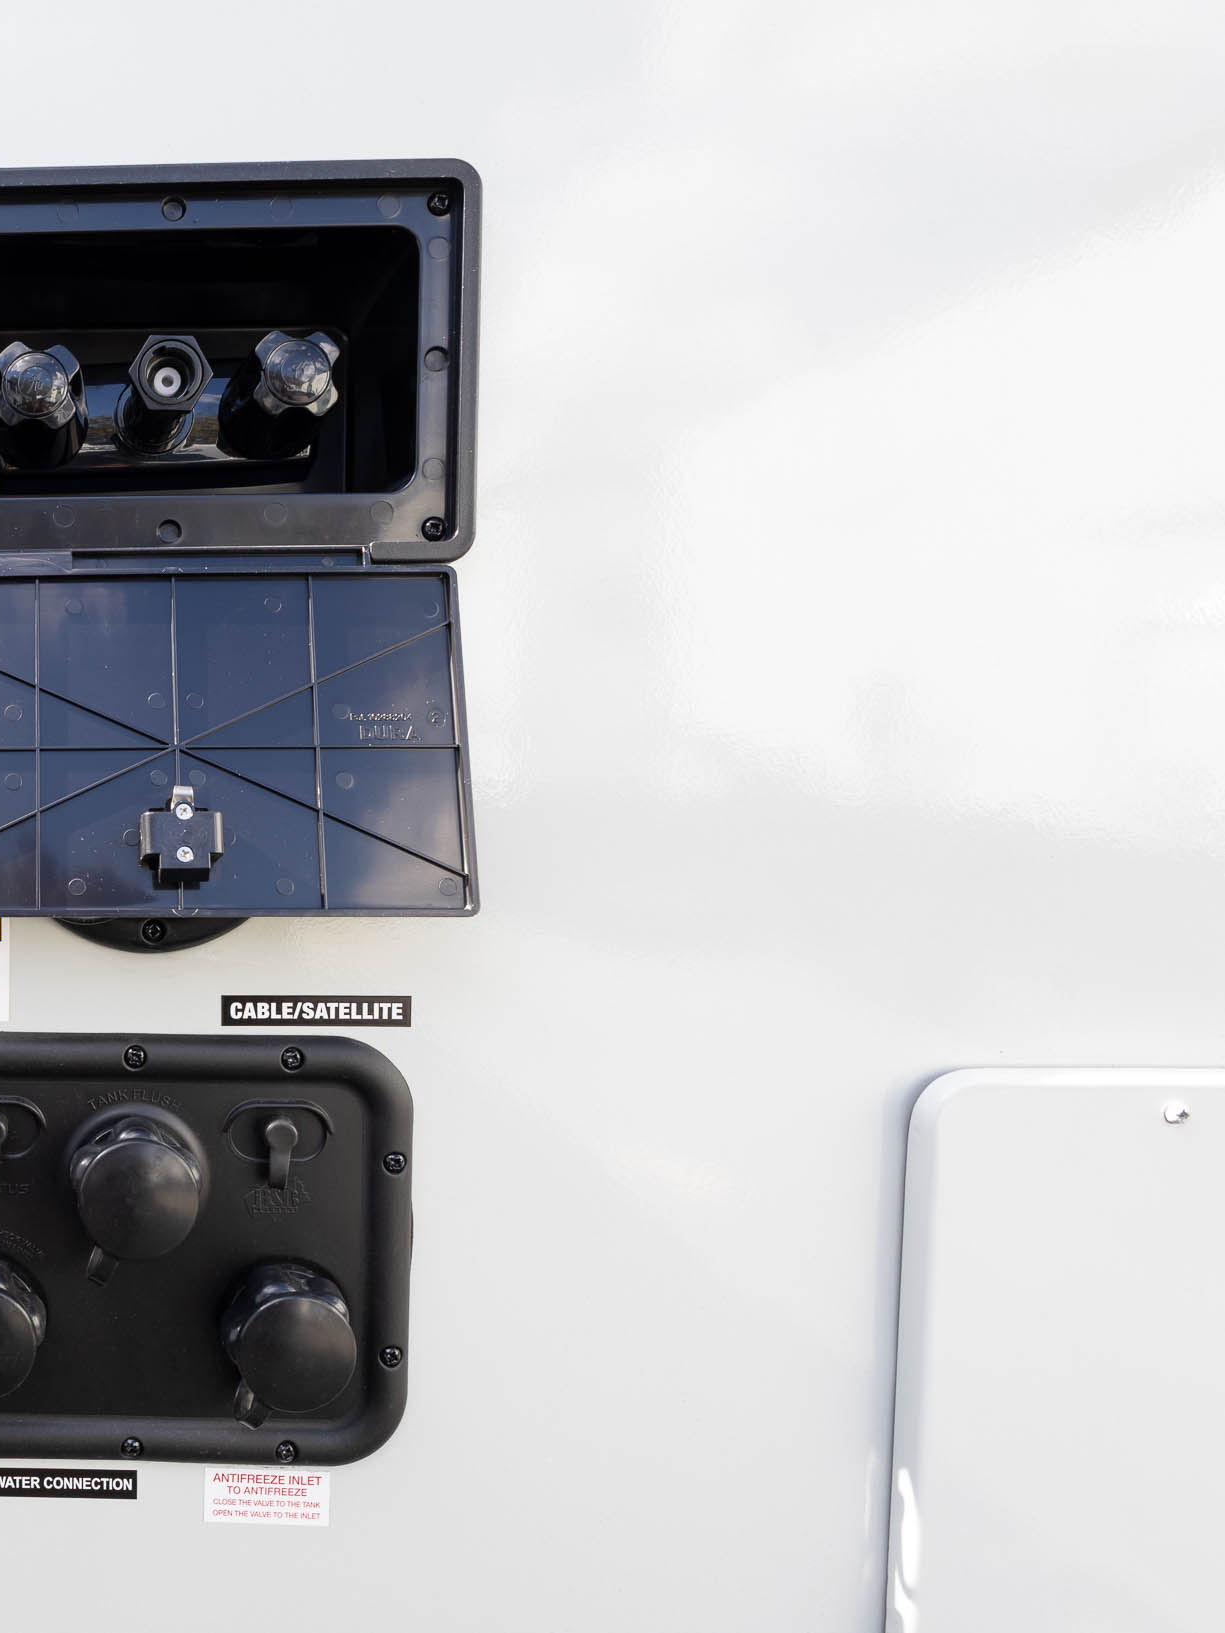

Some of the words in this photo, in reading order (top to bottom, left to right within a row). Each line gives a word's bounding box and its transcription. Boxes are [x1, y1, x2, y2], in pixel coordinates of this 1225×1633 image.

[230, 1002, 403, 1020] CABLE/SATELLITE
[88, 1089, 128, 1112] TANK
[133, 1088, 185, 1113] FLUSH
[44, 1477, 132, 1490] CONNECTION
[213, 1473, 285, 1484] ANTIFREEZE
[289, 1476, 322, 1485] INLET
[227, 1486, 241, 1494] TO
[244, 1487, 307, 1496] ANTIFREEZE
